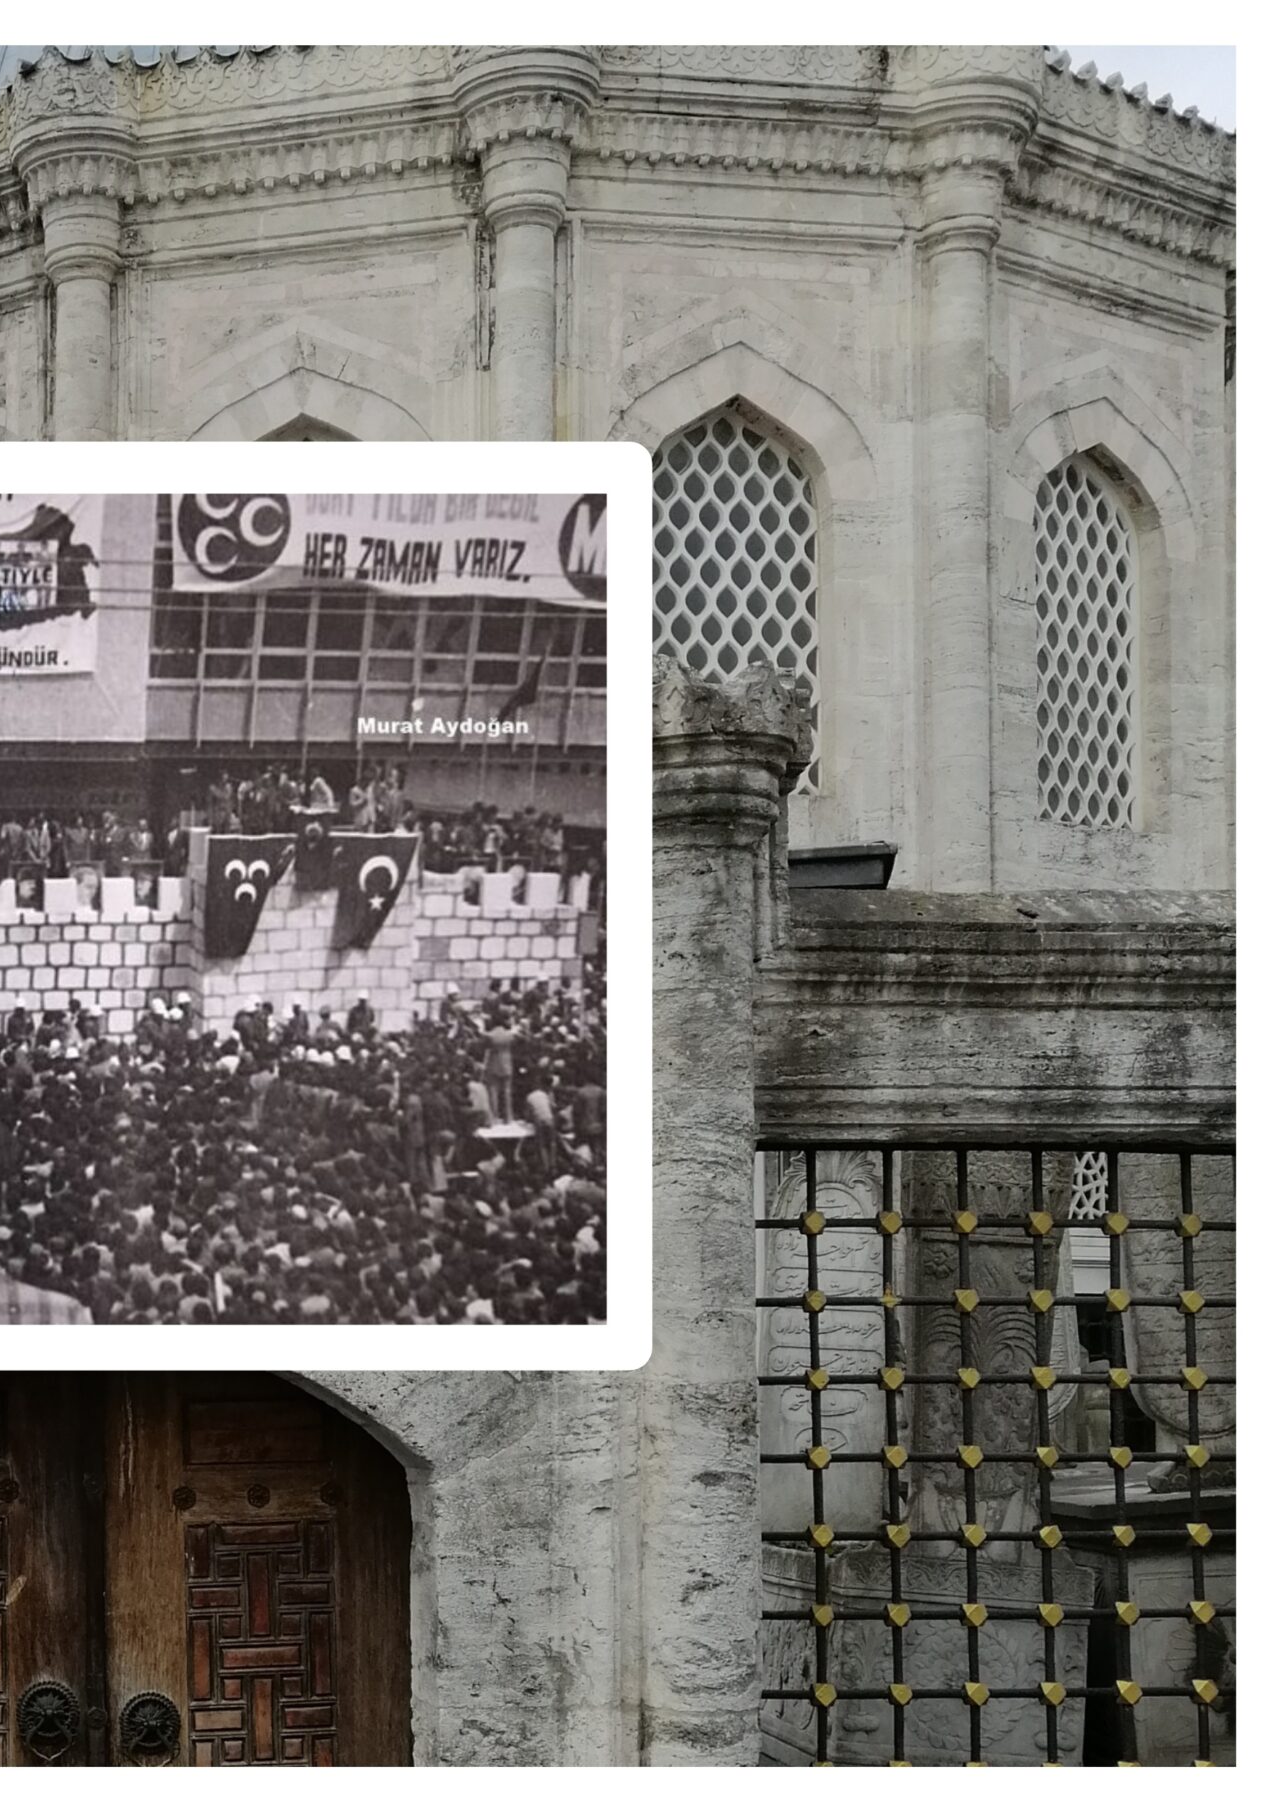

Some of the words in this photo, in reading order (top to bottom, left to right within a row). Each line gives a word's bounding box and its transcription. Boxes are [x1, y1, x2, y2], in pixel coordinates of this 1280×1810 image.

[302, 532, 348, 579] HER
[354, 536, 442, 585] ZAMAN
[455, 537, 530, 583] VARIZ.
